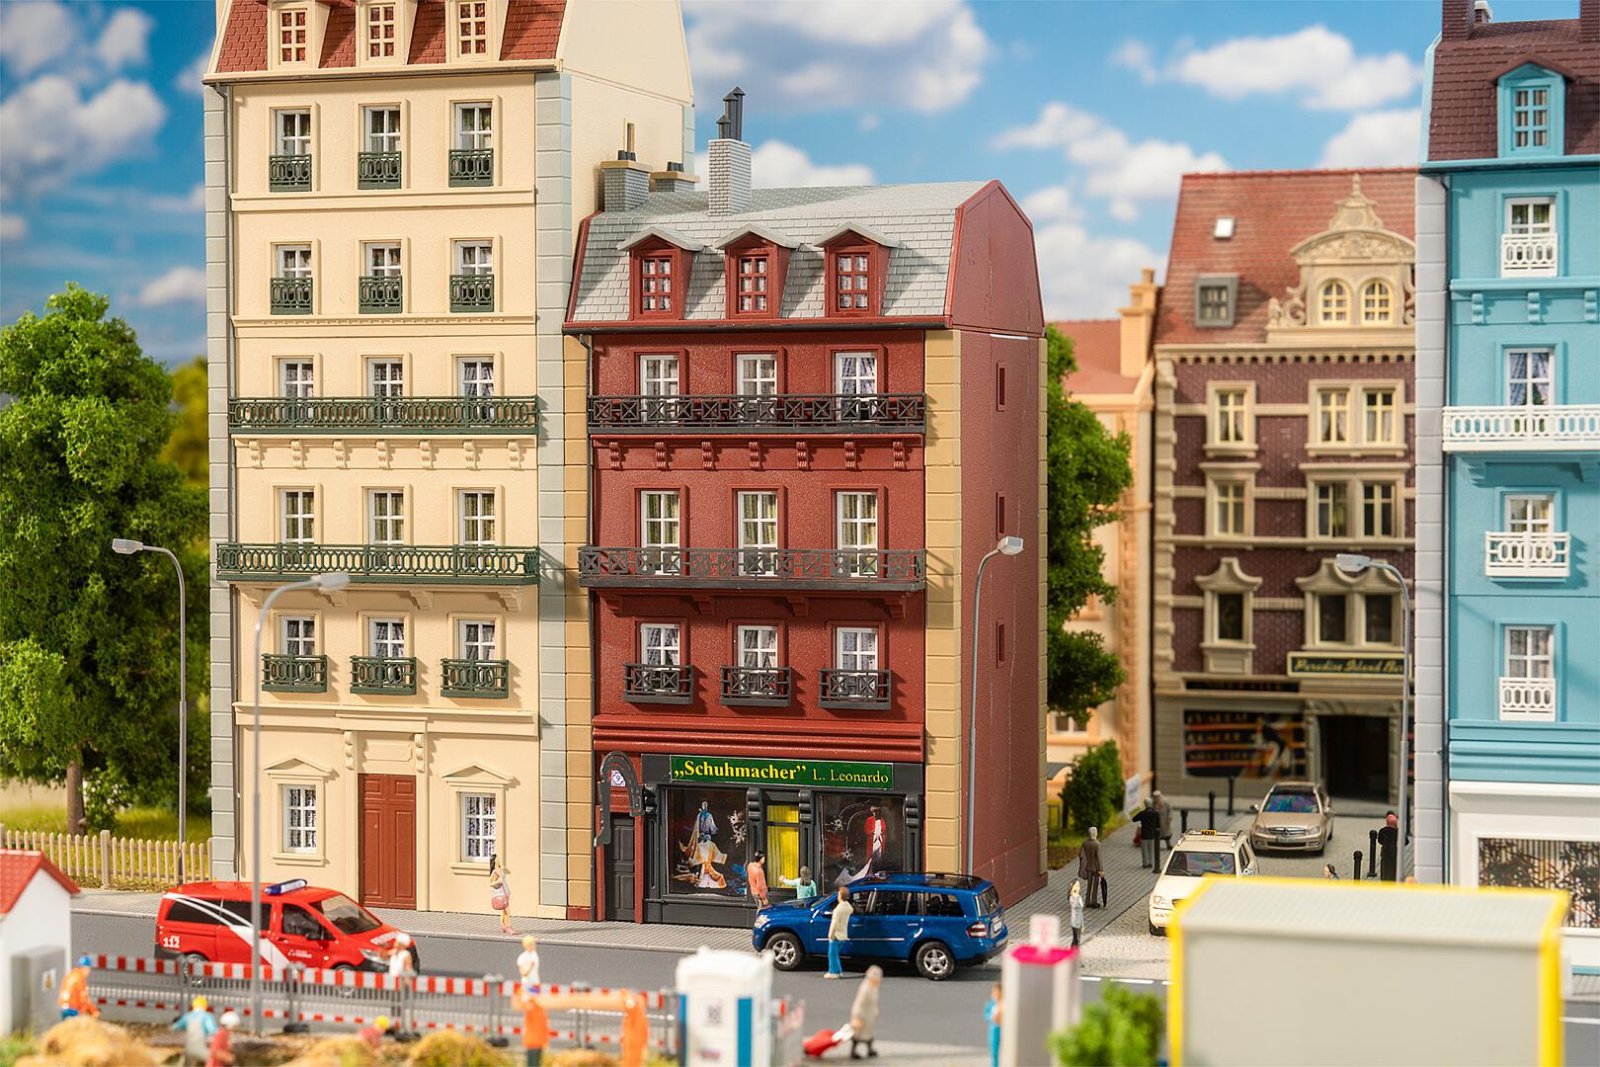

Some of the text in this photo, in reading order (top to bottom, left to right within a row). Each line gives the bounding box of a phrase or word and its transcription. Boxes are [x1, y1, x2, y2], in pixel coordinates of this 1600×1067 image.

[812, 770, 826, 781] L.
[830, 769, 889, 783] Leonardo
[163, 935, 180, 948] 112
